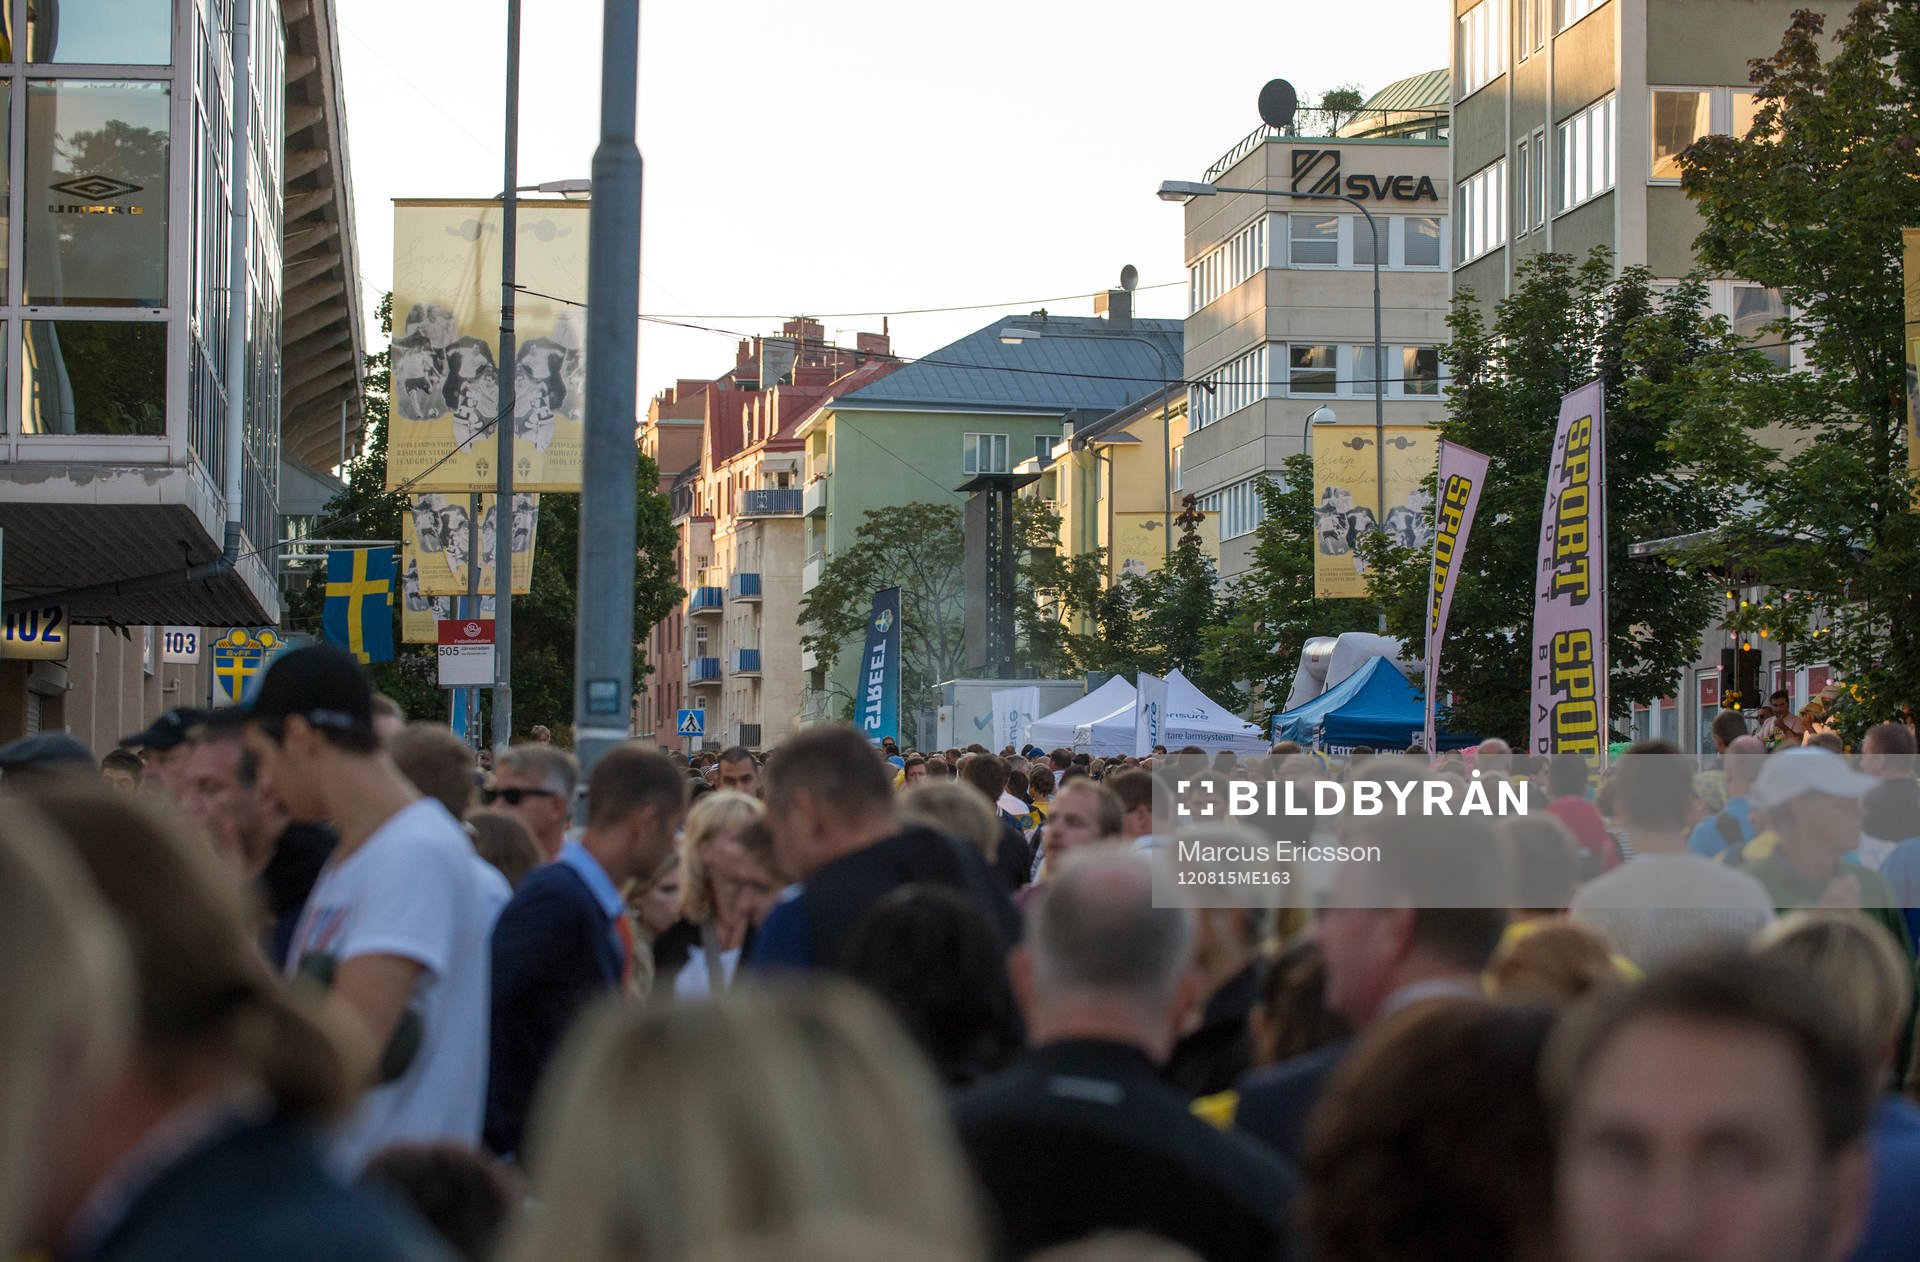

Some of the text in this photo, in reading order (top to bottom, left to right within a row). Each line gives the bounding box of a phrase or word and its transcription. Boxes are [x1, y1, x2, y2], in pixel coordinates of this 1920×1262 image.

[1346, 175, 1439, 201] SVEA
[1541, 434, 1566, 603] BLADET
[1551, 414, 1592, 606] SPORT
[6, 606, 63, 642] 102
[165, 632, 197, 654] 103
[439, 646, 460, 656] 505
[1538, 645, 1549, 754] BLAD
[1185, 731, 1234, 743] larmsystem!
